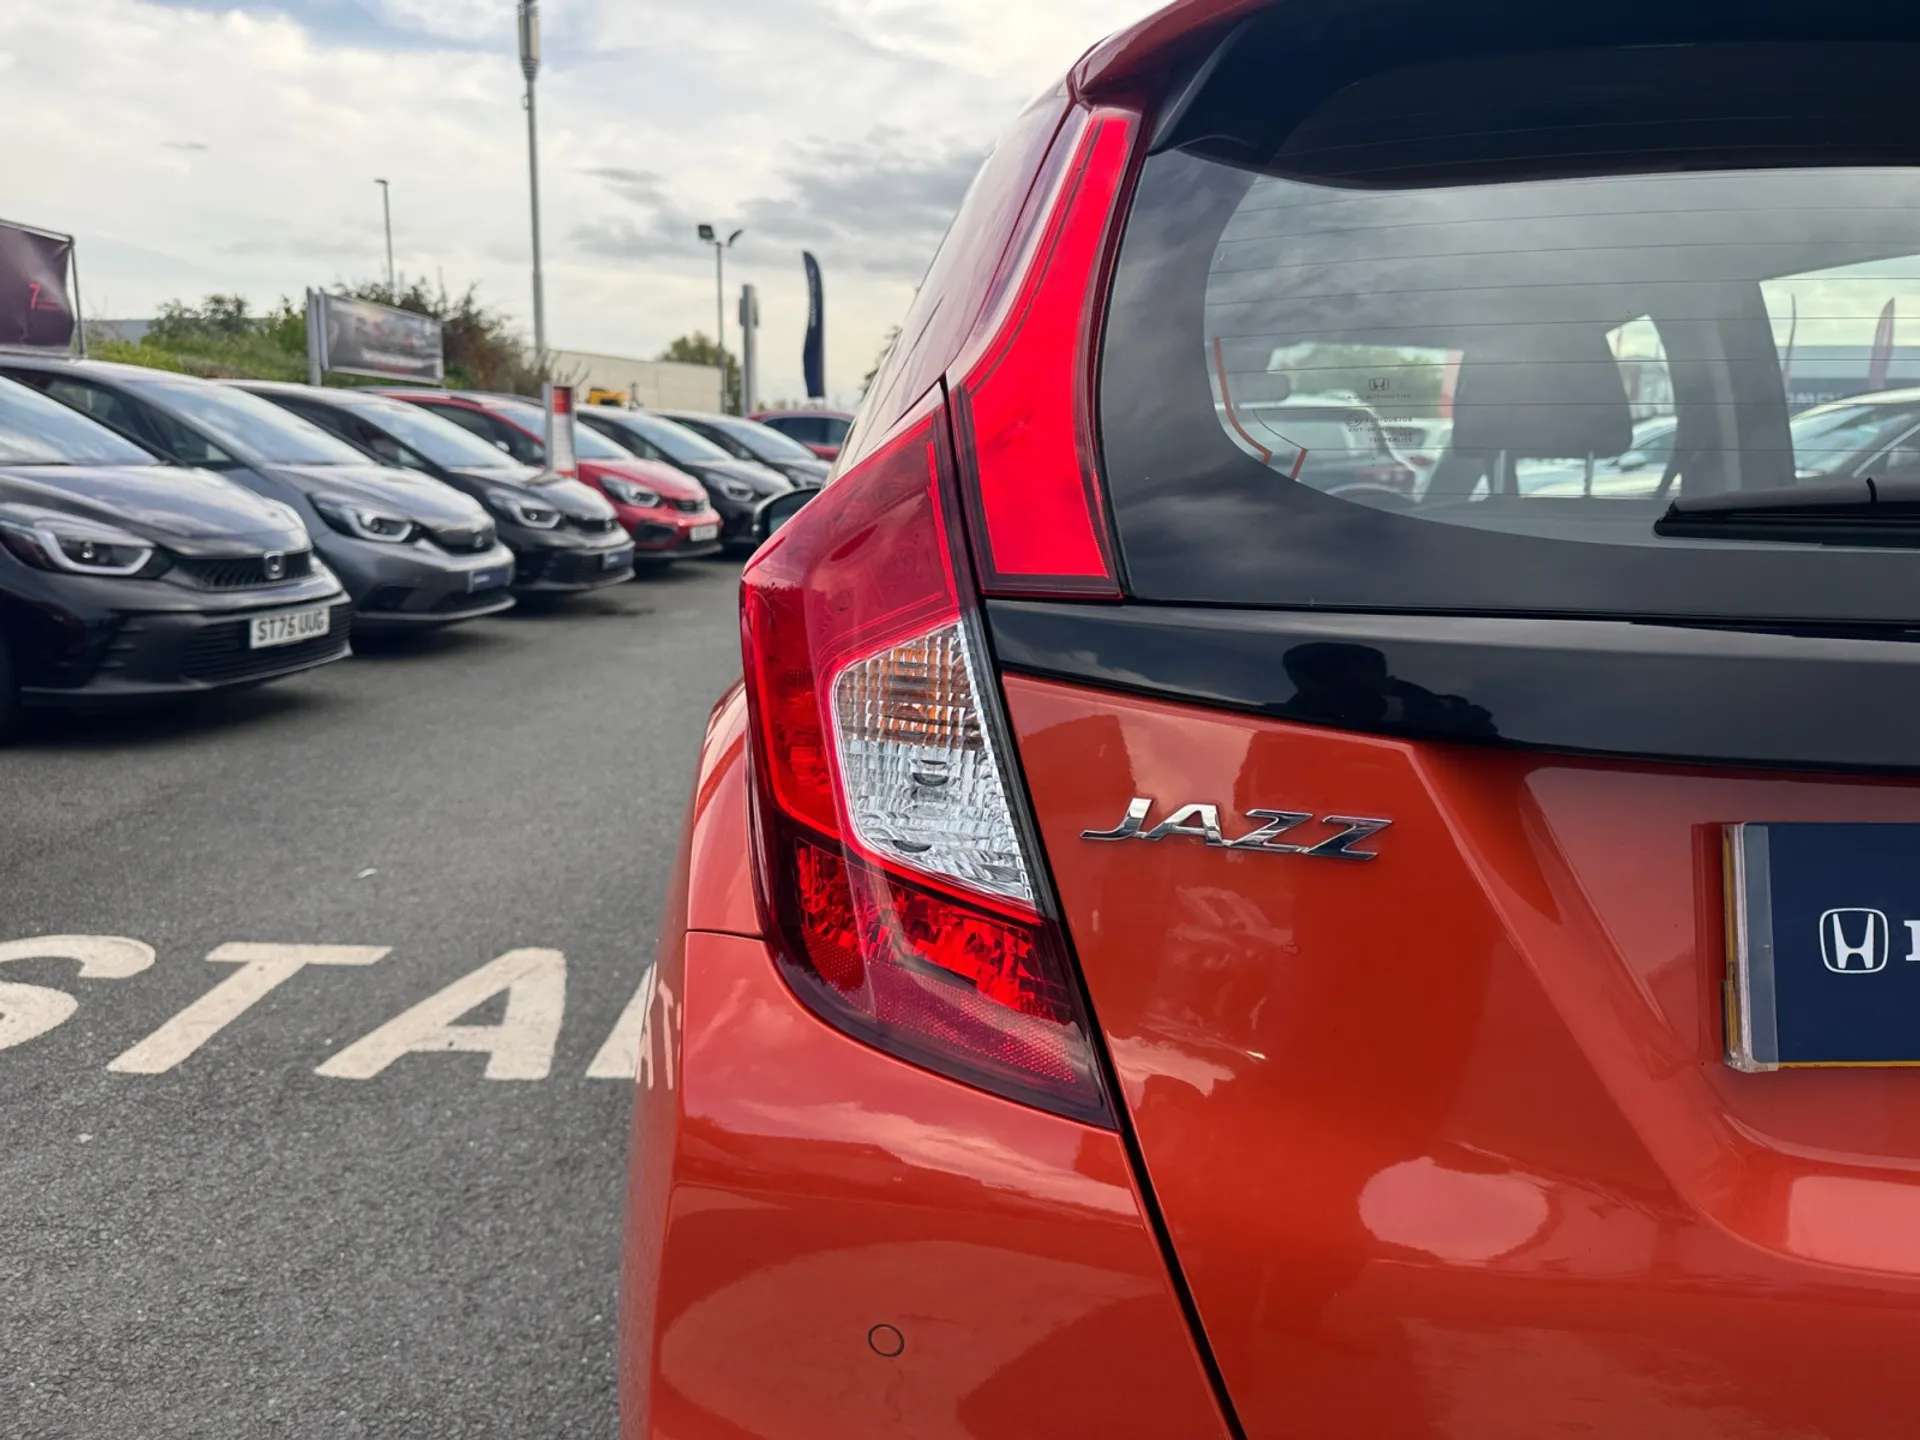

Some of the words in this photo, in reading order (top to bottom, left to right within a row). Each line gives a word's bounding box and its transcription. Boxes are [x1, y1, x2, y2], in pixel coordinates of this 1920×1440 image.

[258, 616, 295, 641] ST75
[1080, 797, 1392, 860] JAZZ
[0, 934, 656, 1081] STA
